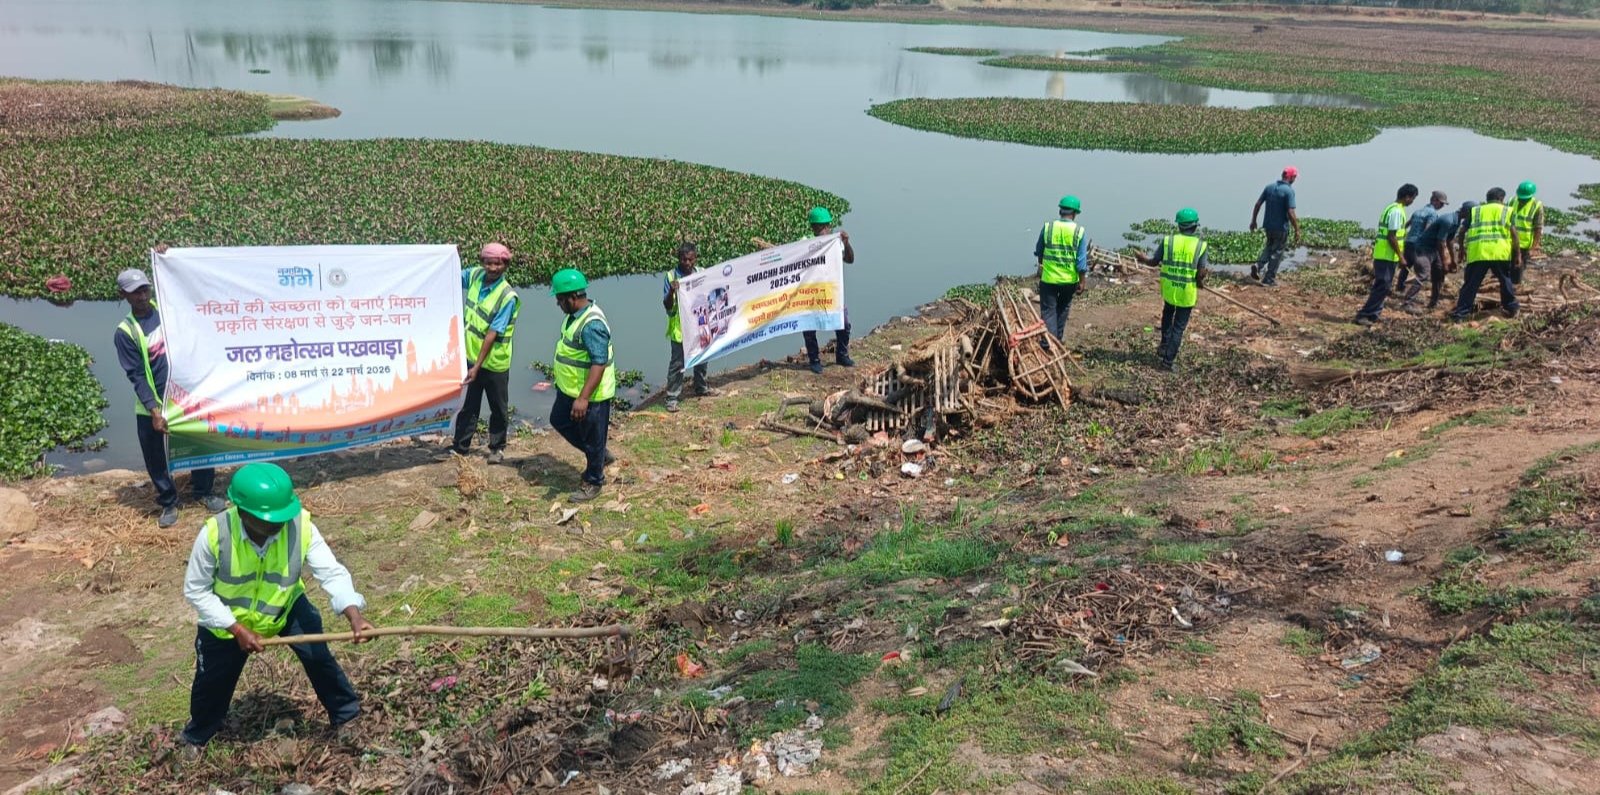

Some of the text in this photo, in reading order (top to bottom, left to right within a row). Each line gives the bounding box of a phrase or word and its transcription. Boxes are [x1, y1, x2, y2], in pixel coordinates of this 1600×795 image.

[746, 268, 778, 285] SWACHH
[770, 273, 801, 289] 2025-26
[195, 294, 426, 315] नदियों की स्वच्छता को बनाएं मिशन
[214, 312, 411, 335] प्रकृति संरक्षण से जुड़े जन-जन
[225, 337, 403, 363] जल महोत्सव पखवाड़ा
[284, 371, 298, 379] 08
[300, 366, 318, 378] मार्च
[320, 366, 329, 377] से
[331, 367, 344, 376] 22
[346, 364, 363, 375] मार्च
[367, 365, 391, 374] 2026
